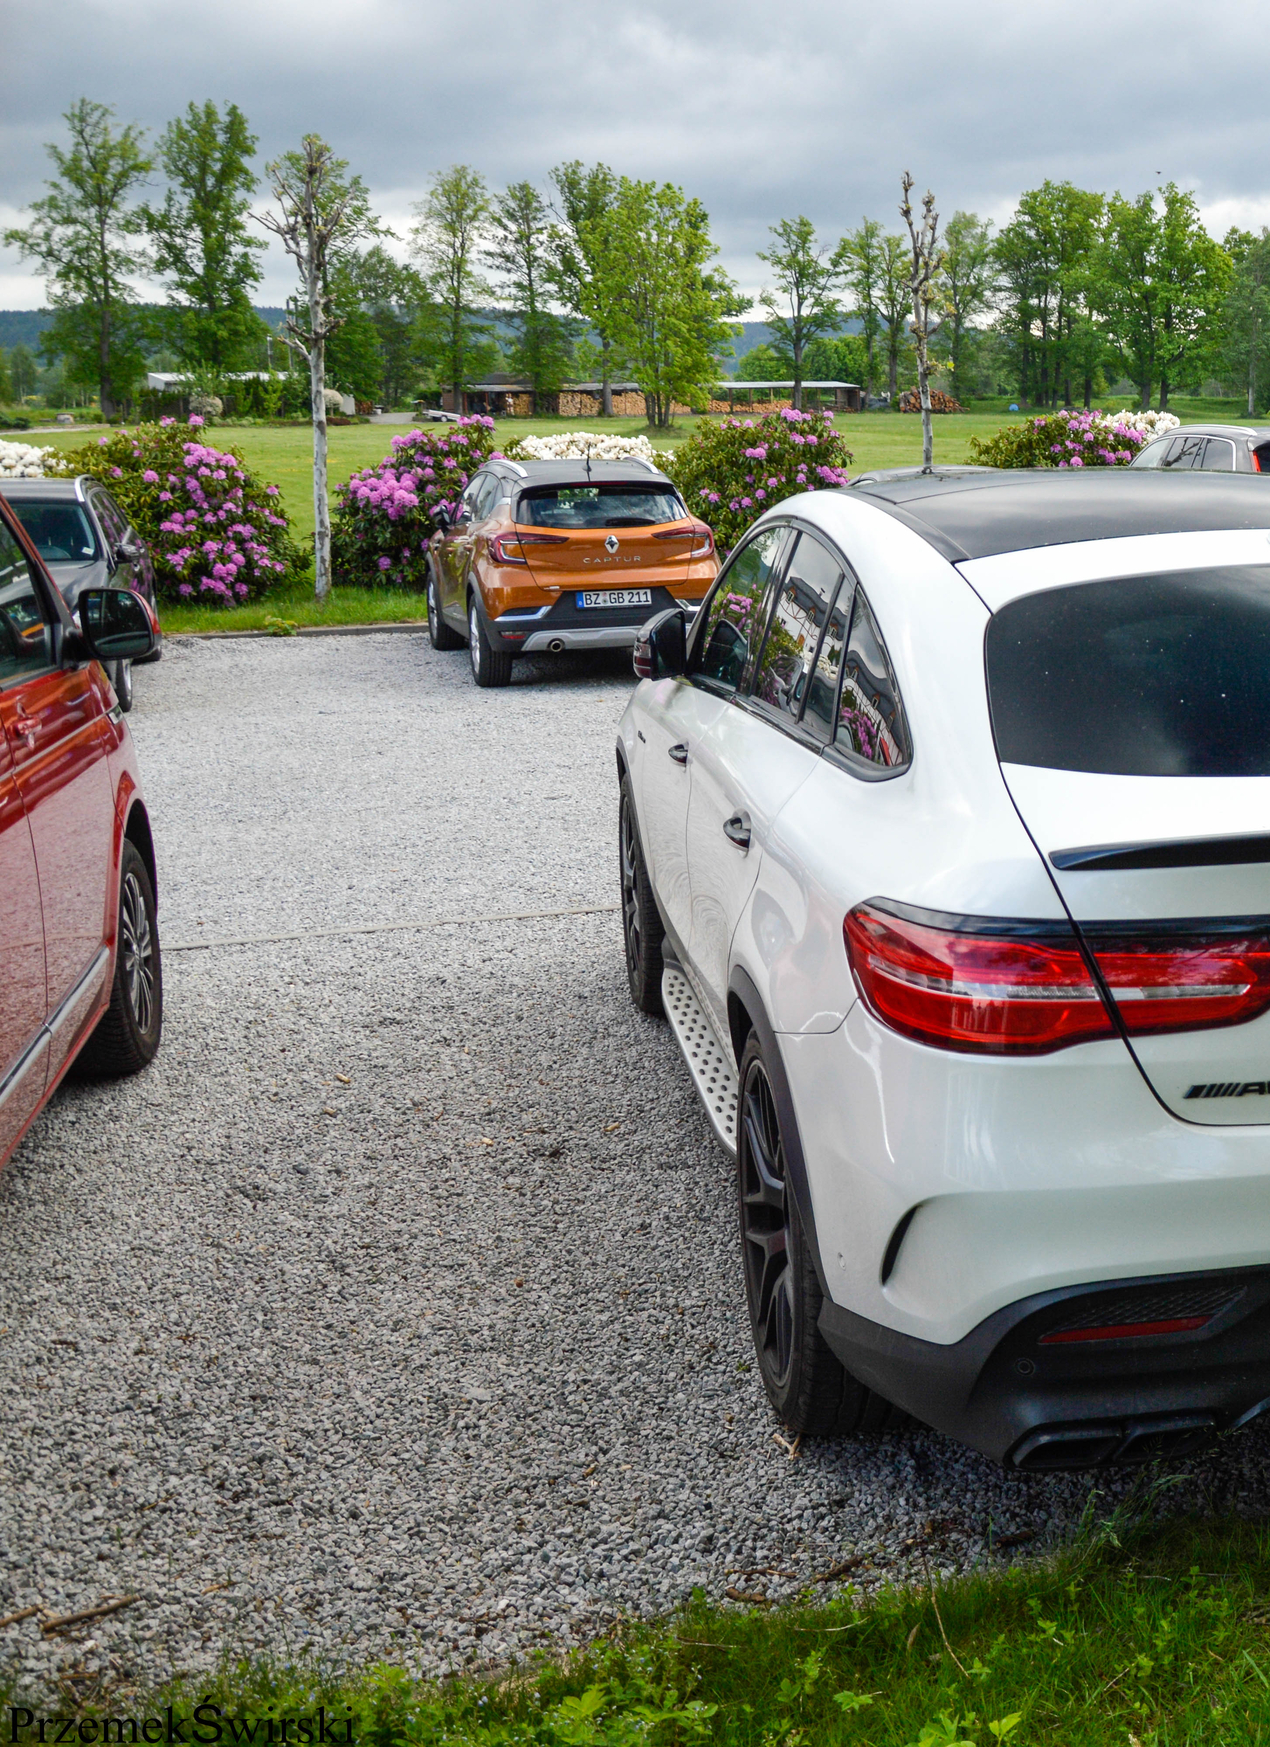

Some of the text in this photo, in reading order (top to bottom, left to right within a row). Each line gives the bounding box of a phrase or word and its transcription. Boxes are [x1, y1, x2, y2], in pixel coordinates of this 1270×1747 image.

[583, 556, 641, 564] CAPTUR
[584, 593, 601, 606] BZ
[609, 592, 625, 604] GB
[627, 591, 650, 603] 211
